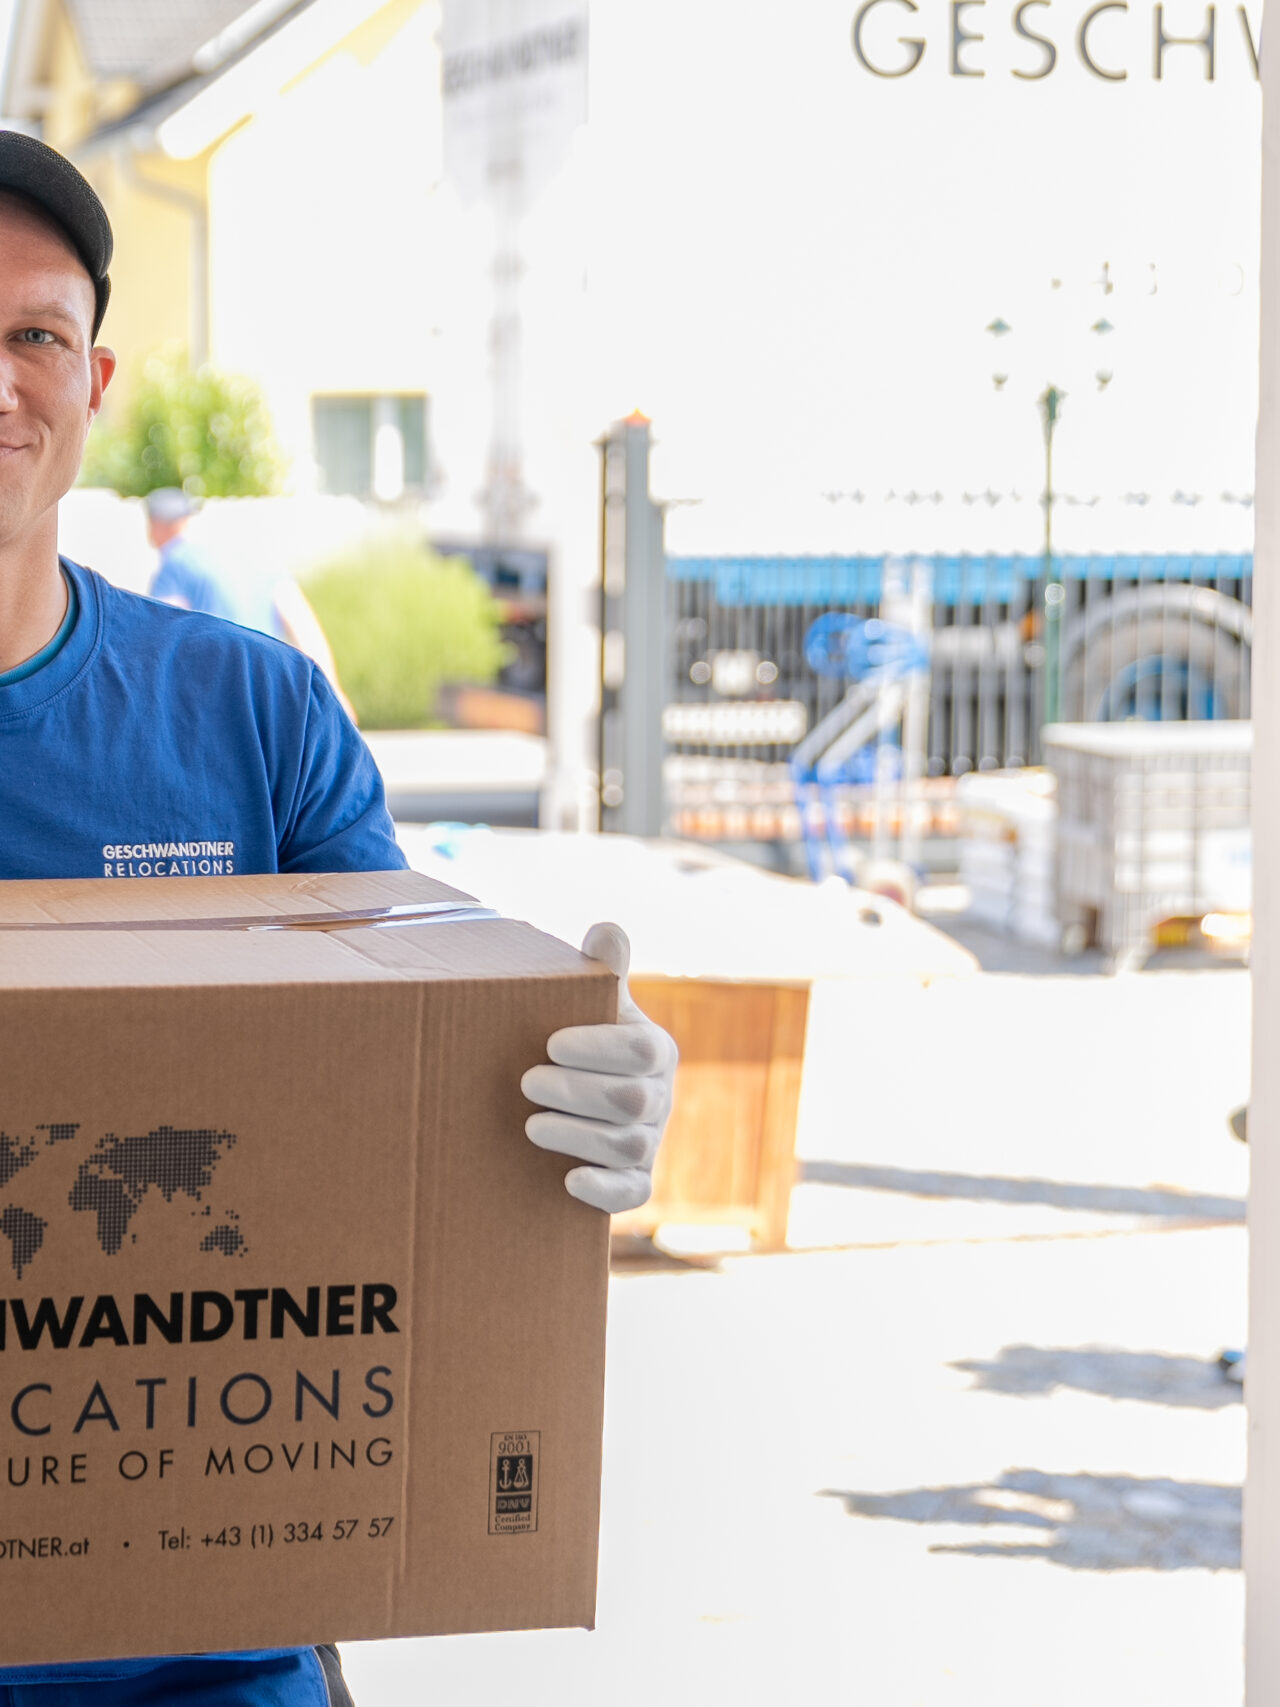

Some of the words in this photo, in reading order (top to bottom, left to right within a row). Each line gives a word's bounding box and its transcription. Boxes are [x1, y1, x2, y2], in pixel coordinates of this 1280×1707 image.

[103, 841, 234, 860] GESCHWANDTNER
[104, 859, 234, 878] RELOCATIONS
[498, 1440, 531, 1454] 9001
[118, 1448, 174, 1481] OF
[204, 1437, 393, 1477] MOVING
[497, 1497, 530, 1510] DNV
[495, 1513, 531, 1524] Certified
[158, 1526, 191, 1551] Tel:
[200, 1525, 241, 1548] +43
[250, 1523, 274, 1550] (1)
[283, 1521, 324, 1544] 334
[332, 1518, 359, 1541] 57
[367, 1516, 395, 1538] 57
[495, 1523, 531, 1533] Company
